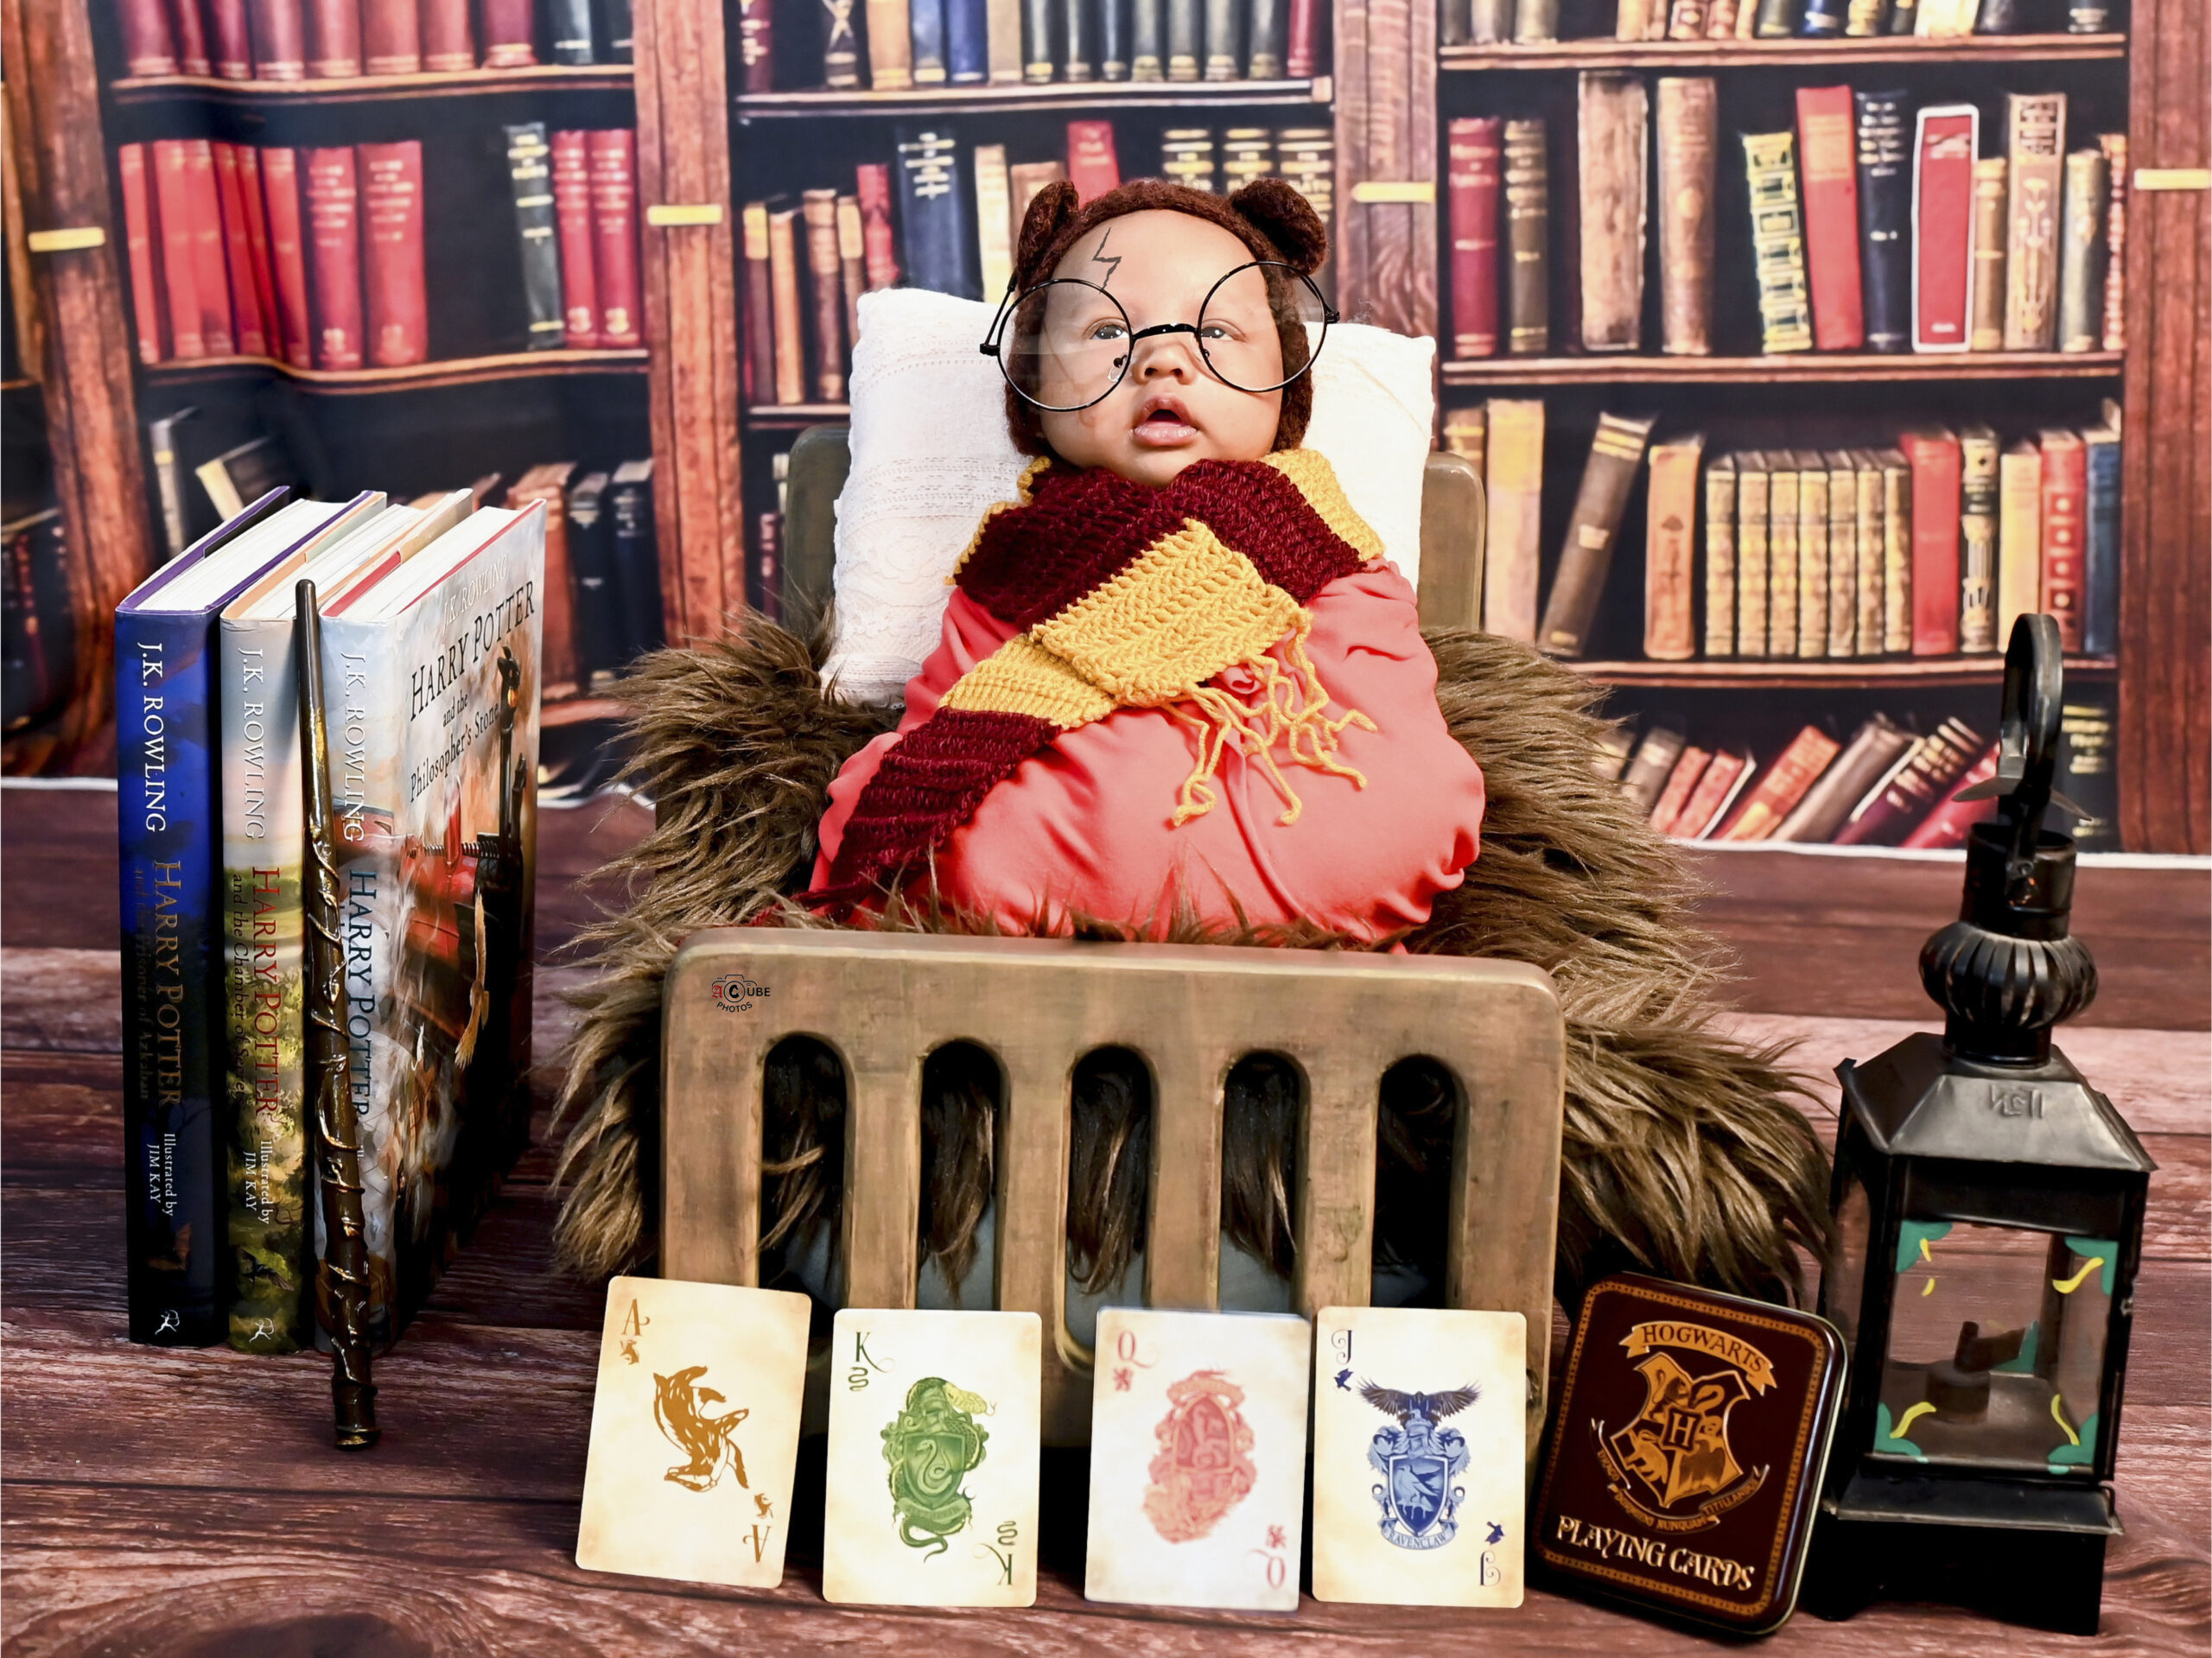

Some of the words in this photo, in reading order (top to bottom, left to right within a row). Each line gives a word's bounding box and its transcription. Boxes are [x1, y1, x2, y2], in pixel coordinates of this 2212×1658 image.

[461, 559, 507, 615] ROWLING
[137, 642, 163, 687] J.K.
[238, 647, 264, 692] J.K.
[341, 651, 365, 697] J.K.
[410, 632, 471, 722] HARRY
[473, 581, 535, 664] POTTER
[442, 704, 456, 727] and
[456, 692, 469, 715] the
[143, 696, 167, 833] ROWLING
[243, 701, 265, 840] ROWLING
[343, 704, 365, 842] ROWLING
[410, 724, 473, 803] Philosopher's
[474, 703, 499, 739] Stone
[233, 874, 248, 904] and
[153, 860, 182, 979] HARRY
[233, 911, 248, 937] the
[252, 867, 281, 983] HARRY
[348, 870, 378, 986] HARRY
[233, 943, 249, 1019] Chamber
[156, 982, 185, 1107] POTTER
[234, 1024, 251, 1042] of
[252, 990, 283, 1115] POTTER
[234, 1047, 249, 1106] Secrets
[148, 1144, 161, 1173] JIM
[162, 1133, 176, 1194] Illustrated
[244, 1151, 256, 1181] JIM
[260, 1140, 272, 1203] Illustrated
[150, 1177, 162, 1204] KAY
[164, 1197, 176, 1217] by
[245, 1185, 257, 1210] KAY
[260, 1206, 273, 1224] by
[622, 1298, 651, 1336] A
[854, 1331, 894, 1373] K
[1116, 1331, 1160, 1369] Q
[1332, 1329, 1353, 1365] J
[1642, 1325, 1766, 1372] HOGWARTS
[1669, 1412, 1697, 1447] H
[743, 1525, 772, 1564] A
[1388, 1529, 1448, 1550] RAVENCLAW
[1556, 1516, 1667, 1568] PLAYING
[1670, 1547, 1755, 1591] CARDS
[973, 1543, 1012, 1585] K
